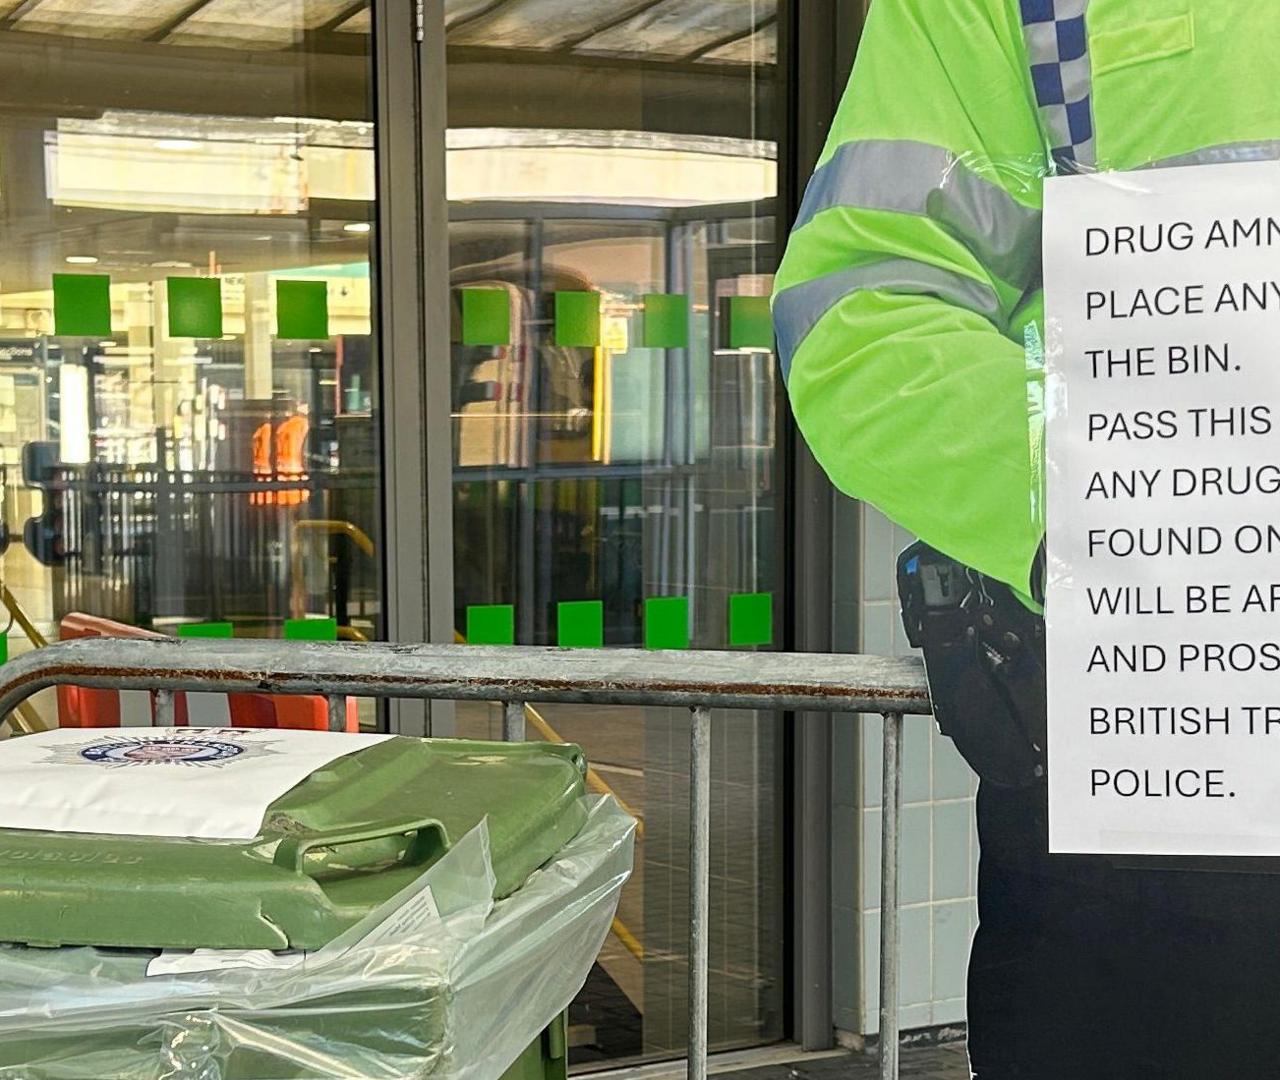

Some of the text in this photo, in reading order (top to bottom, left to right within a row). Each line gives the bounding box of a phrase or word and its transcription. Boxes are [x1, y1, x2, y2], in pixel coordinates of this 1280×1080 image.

[1086, 222, 1194, 257] DRUG
[1086, 284, 1204, 320] PLACE
[1084, 343, 1241, 379] THE BIN.
[1088, 410, 1178, 442] PASS
[1187, 405, 1272, 437] THIS
[1084, 469, 1162, 500] ANY
[1088, 526, 1222, 558] FOUND
[1086, 586, 1175, 615] WILL
[1186, 585, 1231, 614] BE
[1086, 644, 1166, 673] AND
[1090, 706, 1230, 735] BRITISH
[1091, 768, 1236, 798] POLICE.
